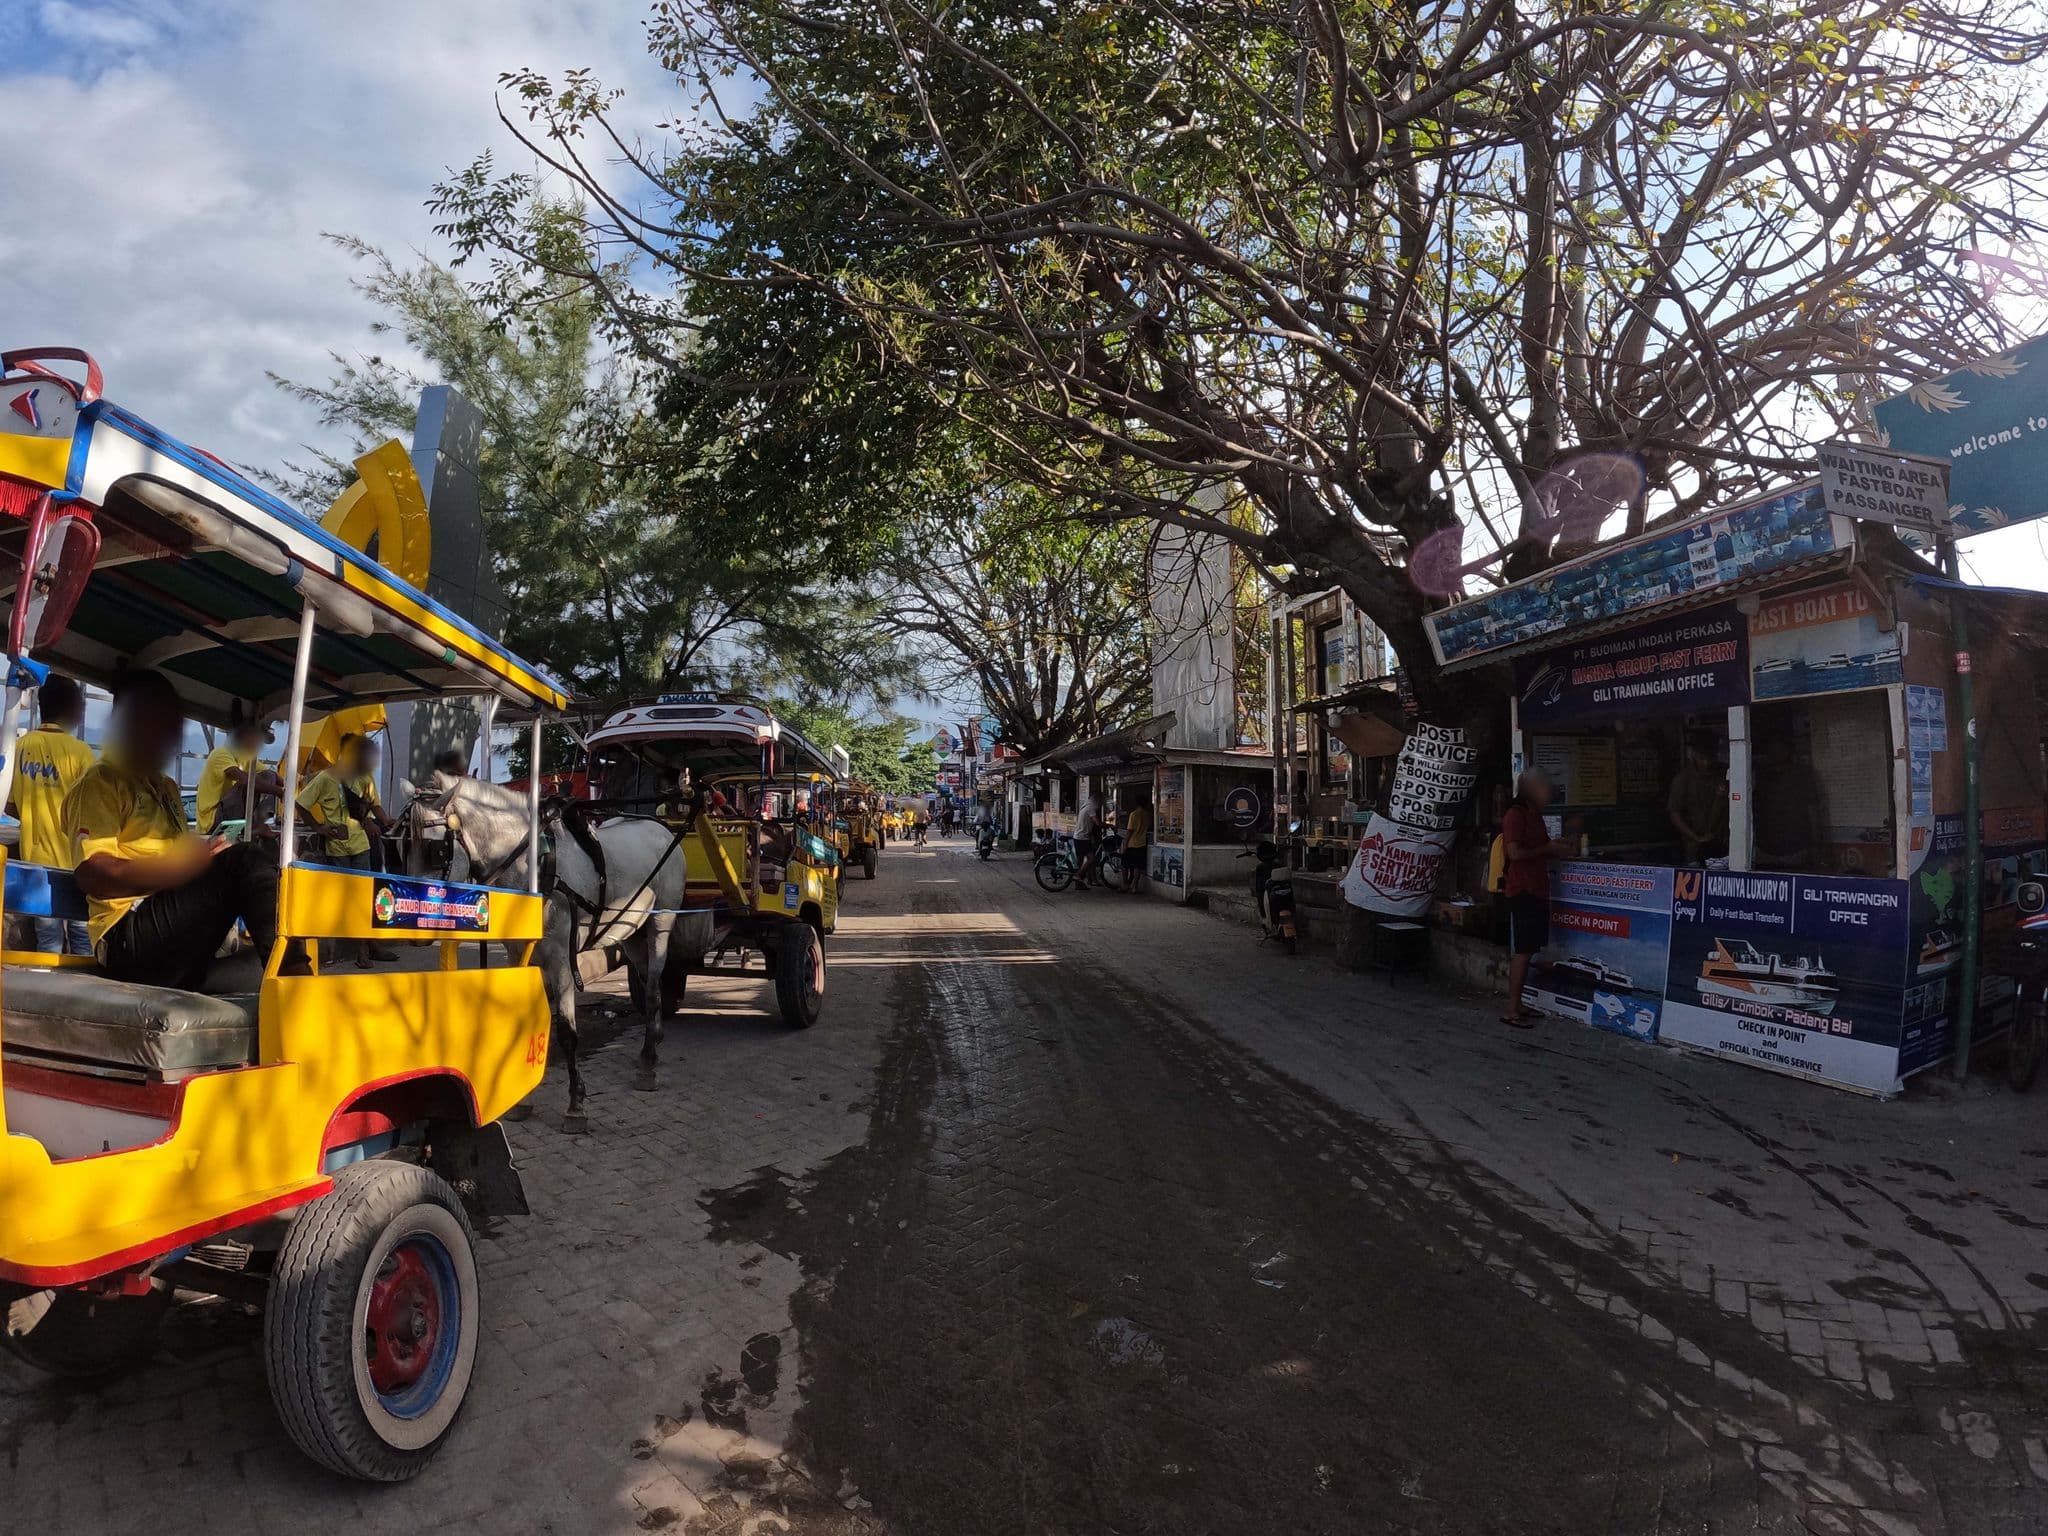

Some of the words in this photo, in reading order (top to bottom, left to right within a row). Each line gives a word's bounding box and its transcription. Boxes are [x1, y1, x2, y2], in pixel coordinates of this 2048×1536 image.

[1950, 426, 2022, 458] welcome
[2027, 416, 2048, 432] to
[1820, 453, 1895, 479] WAITING
[1898, 468, 1940, 487] AREA
[1838, 471, 1925, 501] FASTBOAT
[1833, 489, 1934, 521] PASSANGER
[1793, 595, 1838, 623] BOAT
[1590, 641, 1637, 659] BUDIMAN
[1638, 632, 1673, 648] INDAH
[1676, 620, 1732, 641] PERKASA
[1659, 649, 1692, 671] FAST
[1694, 640, 1738, 665] FERRY
[1593, 686, 1612, 702] GILI
[1613, 678, 1675, 699] TRAWANGAN
[1677, 673, 1715, 692] OFFICE
[1418, 723, 1461, 743] POST
[1407, 738, 1476, 762] SERVICE
[1386, 846, 1415, 866] KAMI
[1373, 871, 1398, 889] HAK
[1587, 875, 1611, 886] GROUP
[1612, 877, 1630, 888] FAST
[1631, 879, 1655, 890] FERRY
[1675, 872, 1701, 900] KJ
[1707, 876, 1745, 898] KARUNIYA
[1746, 878, 1778, 901] LUXURY
[1779, 880, 1788, 902] 01
[395, 900, 419, 913] JANUR
[420, 901, 440, 914] INDAH
[1620, 892, 1640, 901] OFFICE
[1803, 889, 1822, 901] GILI
[1824, 890, 1898, 907] TRAWANGAN
[1552, 913, 1580, 926] CHECK
[1582, 916, 1591, 927] IN
[1592, 918, 1619, 931] POINT
[1710, 907, 1724, 919] Daily
[1725, 908, 1738, 919] Fast
[1739, 910, 1753, 920] Boat
[1755, 911, 1784, 924] Transfers
[1830, 910, 1869, 925] OFFICE
[1702, 993, 1730, 1009] Gilis/
[1732, 1000, 1774, 1018] Lombok
[1785, 1010, 1828, 1033] Padang
[1832, 1018, 1852, 1034] Bai
[1737, 1020, 1765, 1034] CHECK
[1767, 1027, 1776, 1037] IN
[1778, 1028, 1806, 1043] POINT
[1762, 1039, 1777, 1049] and
[1719, 1040, 1750, 1055] OFFICIAL
[1752, 1047, 1790, 1065] TICKETING
[1791, 1057, 1822, 1073] SERVICE
